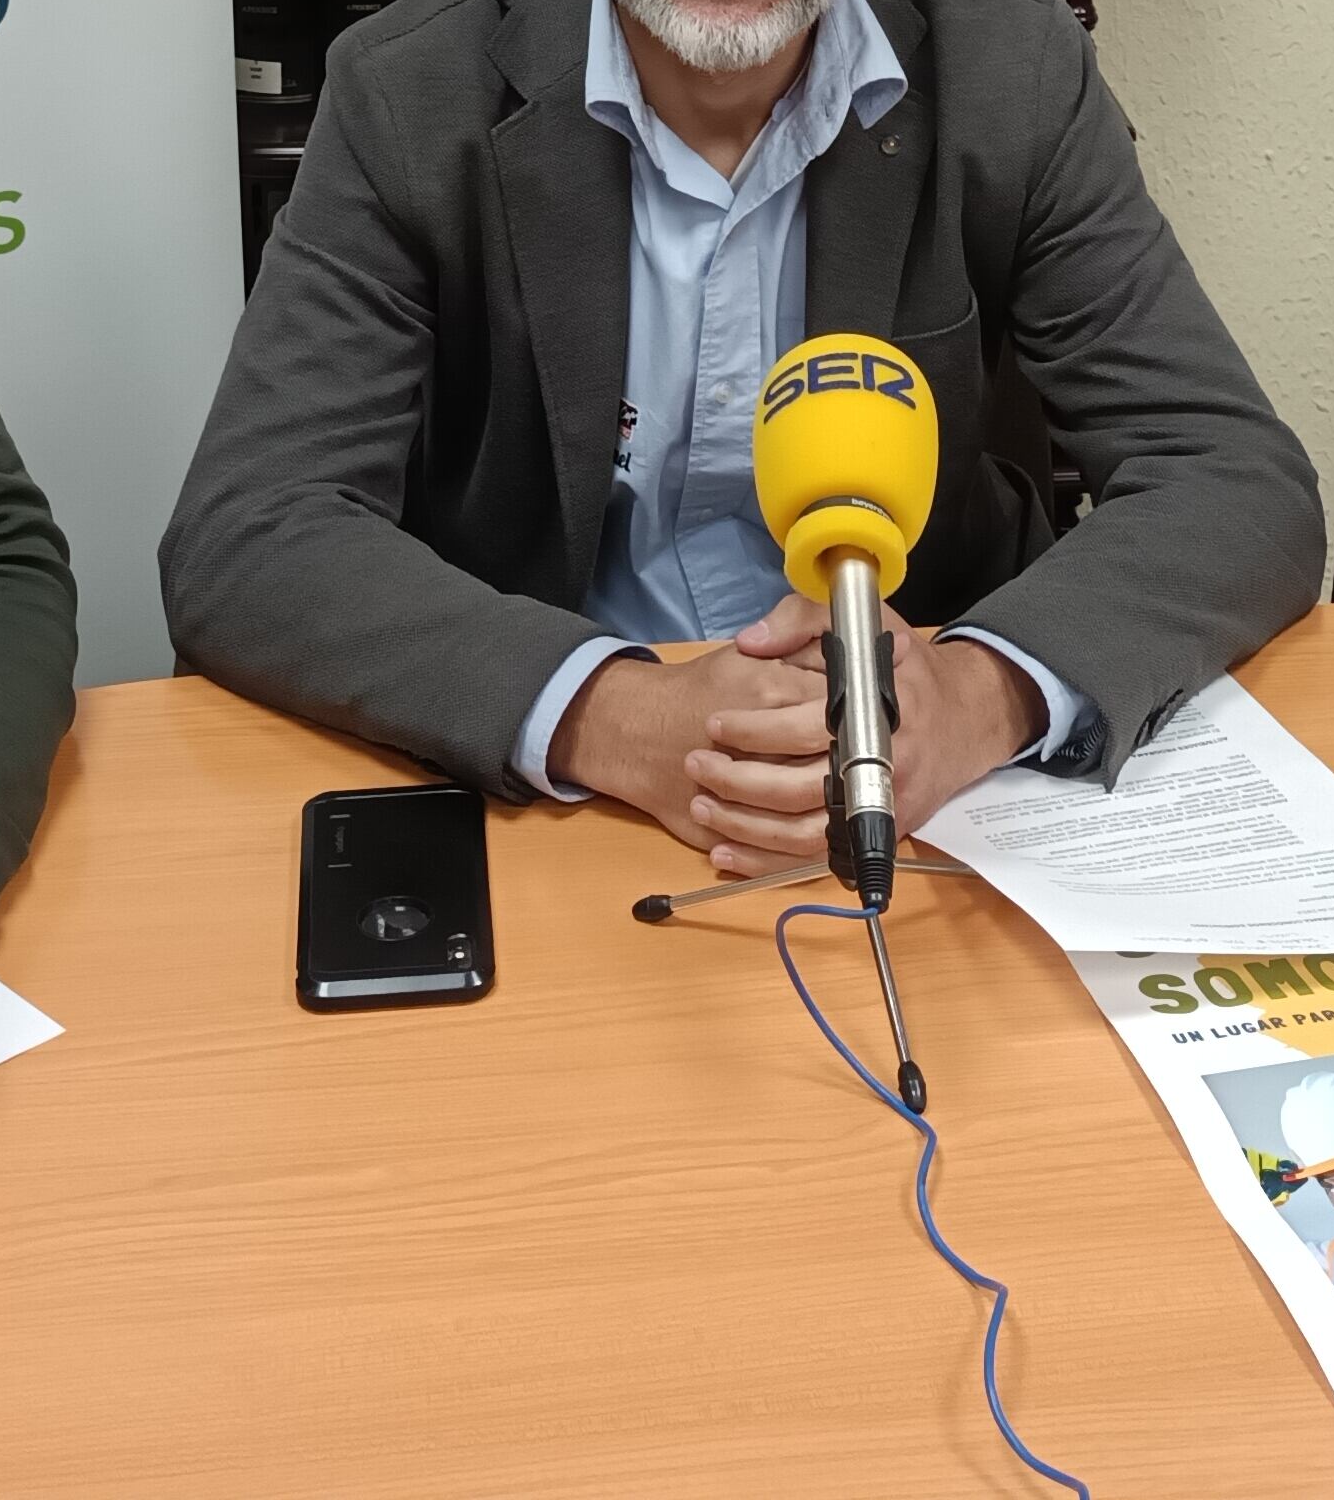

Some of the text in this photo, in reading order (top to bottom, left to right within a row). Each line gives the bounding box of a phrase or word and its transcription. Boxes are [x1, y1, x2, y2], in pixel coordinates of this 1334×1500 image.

[763, 352, 917, 425] SER
[1171, 1030, 1205, 1044] UN
[1211, 1016, 1288, 1039] LUGAR
